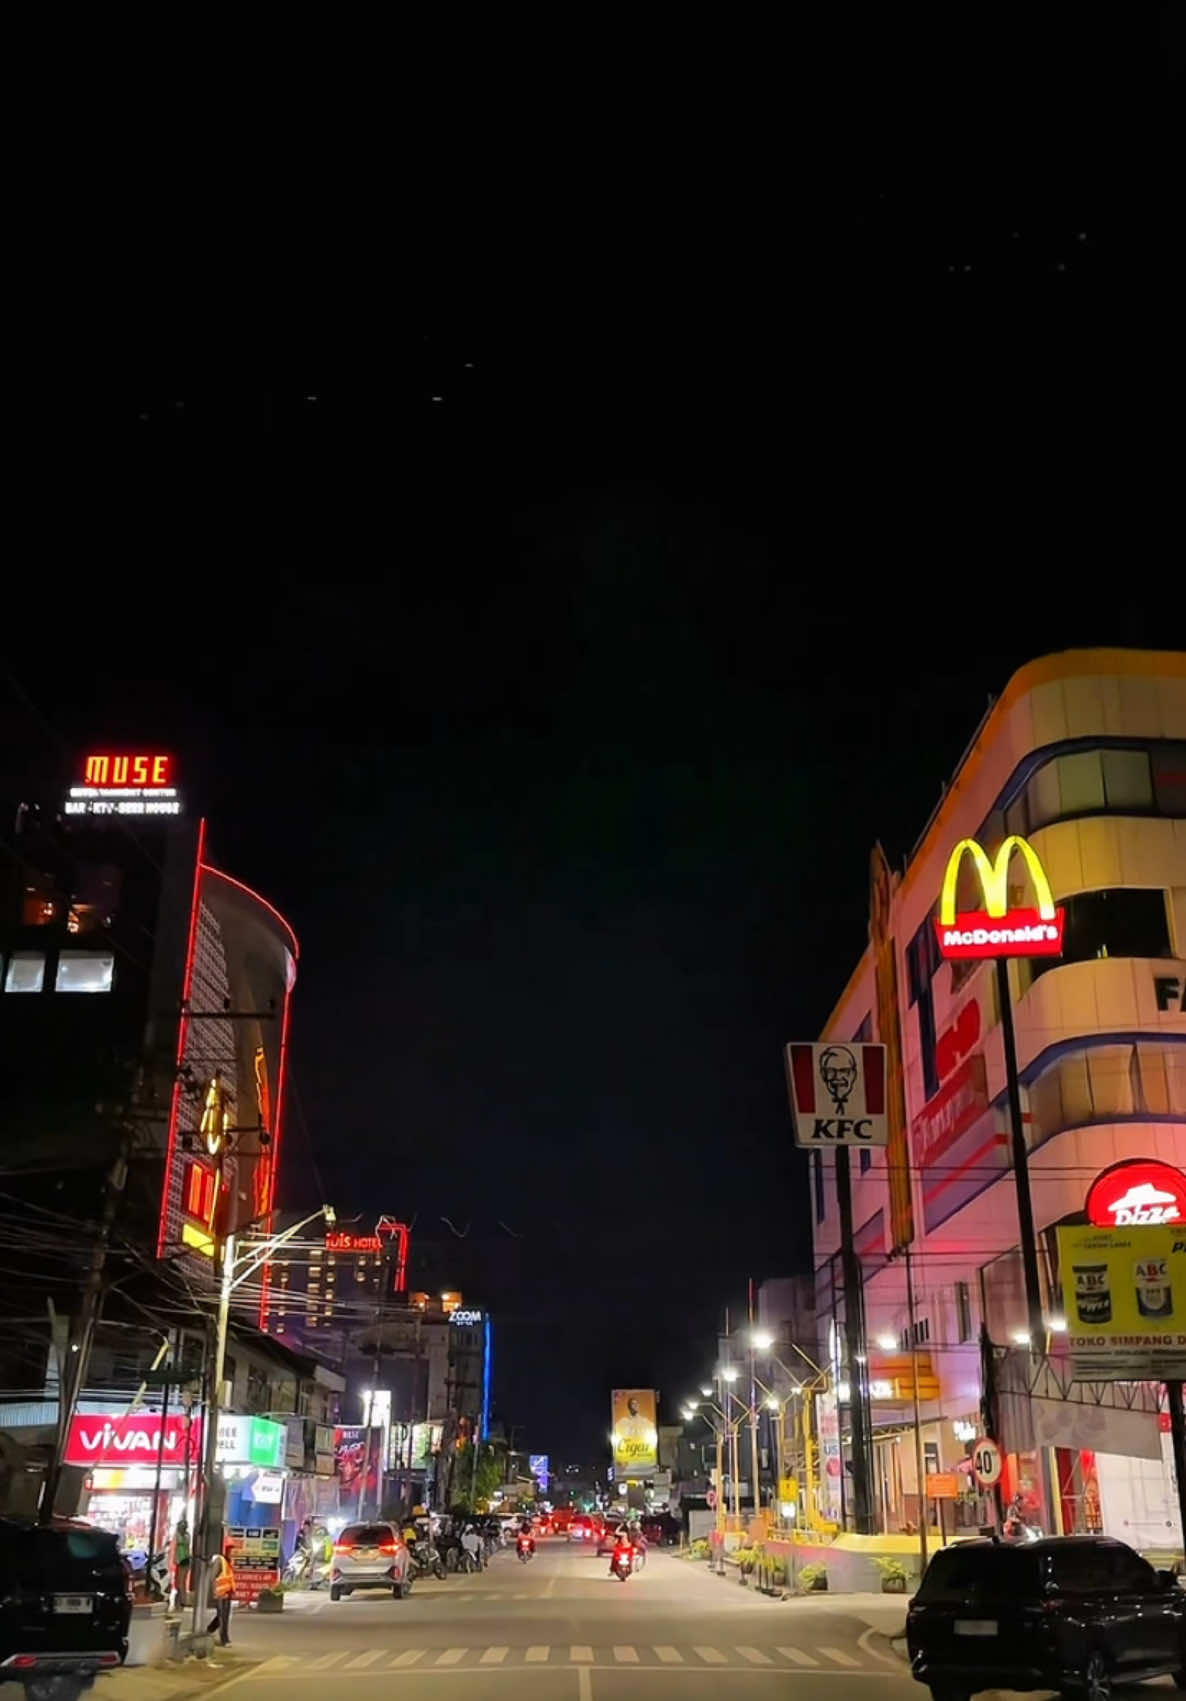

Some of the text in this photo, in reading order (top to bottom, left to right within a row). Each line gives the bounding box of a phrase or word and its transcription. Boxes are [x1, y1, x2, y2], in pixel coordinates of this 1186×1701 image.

[84, 756, 169, 783] MUSE
[943, 925, 1059, 947] McDonald's
[811, 1118, 873, 1140] KFC
[1076, 1274, 1107, 1287] ABC
[1134, 1262, 1170, 1277] ABC
[1110, 1334, 1173, 1346] SIMPANG
[976, 1449, 993, 1475] 40
